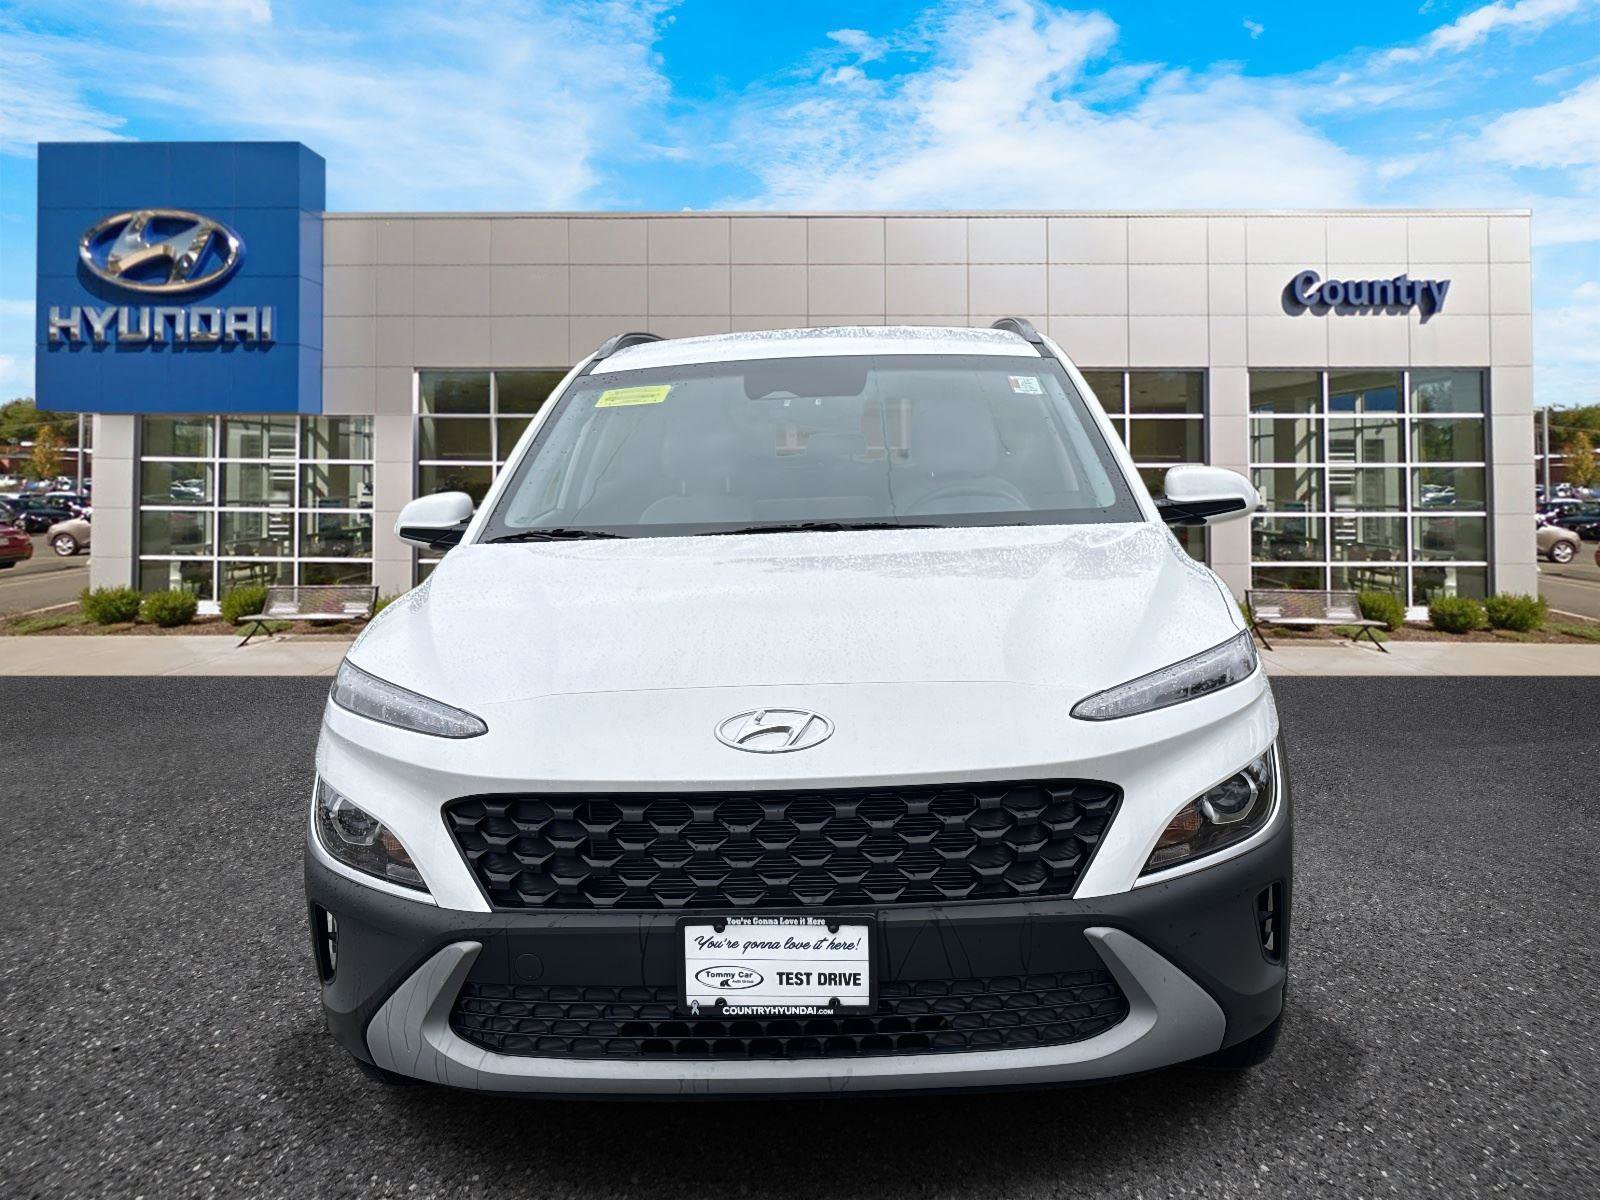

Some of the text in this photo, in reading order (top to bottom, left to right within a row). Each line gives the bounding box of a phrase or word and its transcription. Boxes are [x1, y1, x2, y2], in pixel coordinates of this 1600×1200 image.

[1282, 270, 1451, 324] Country
[48, 306, 272, 342] HYUNDAI
[753, 917, 778, 925] Gonna
[780, 917, 798, 925] Love
[799, 917, 806, 925] it
[807, 917, 826, 925] Here
[694, 936, 861, 954] You're gonna love it here!
[705, 971, 735, 980] Tommy
[776, 972, 862, 986] TEST DRIVE
